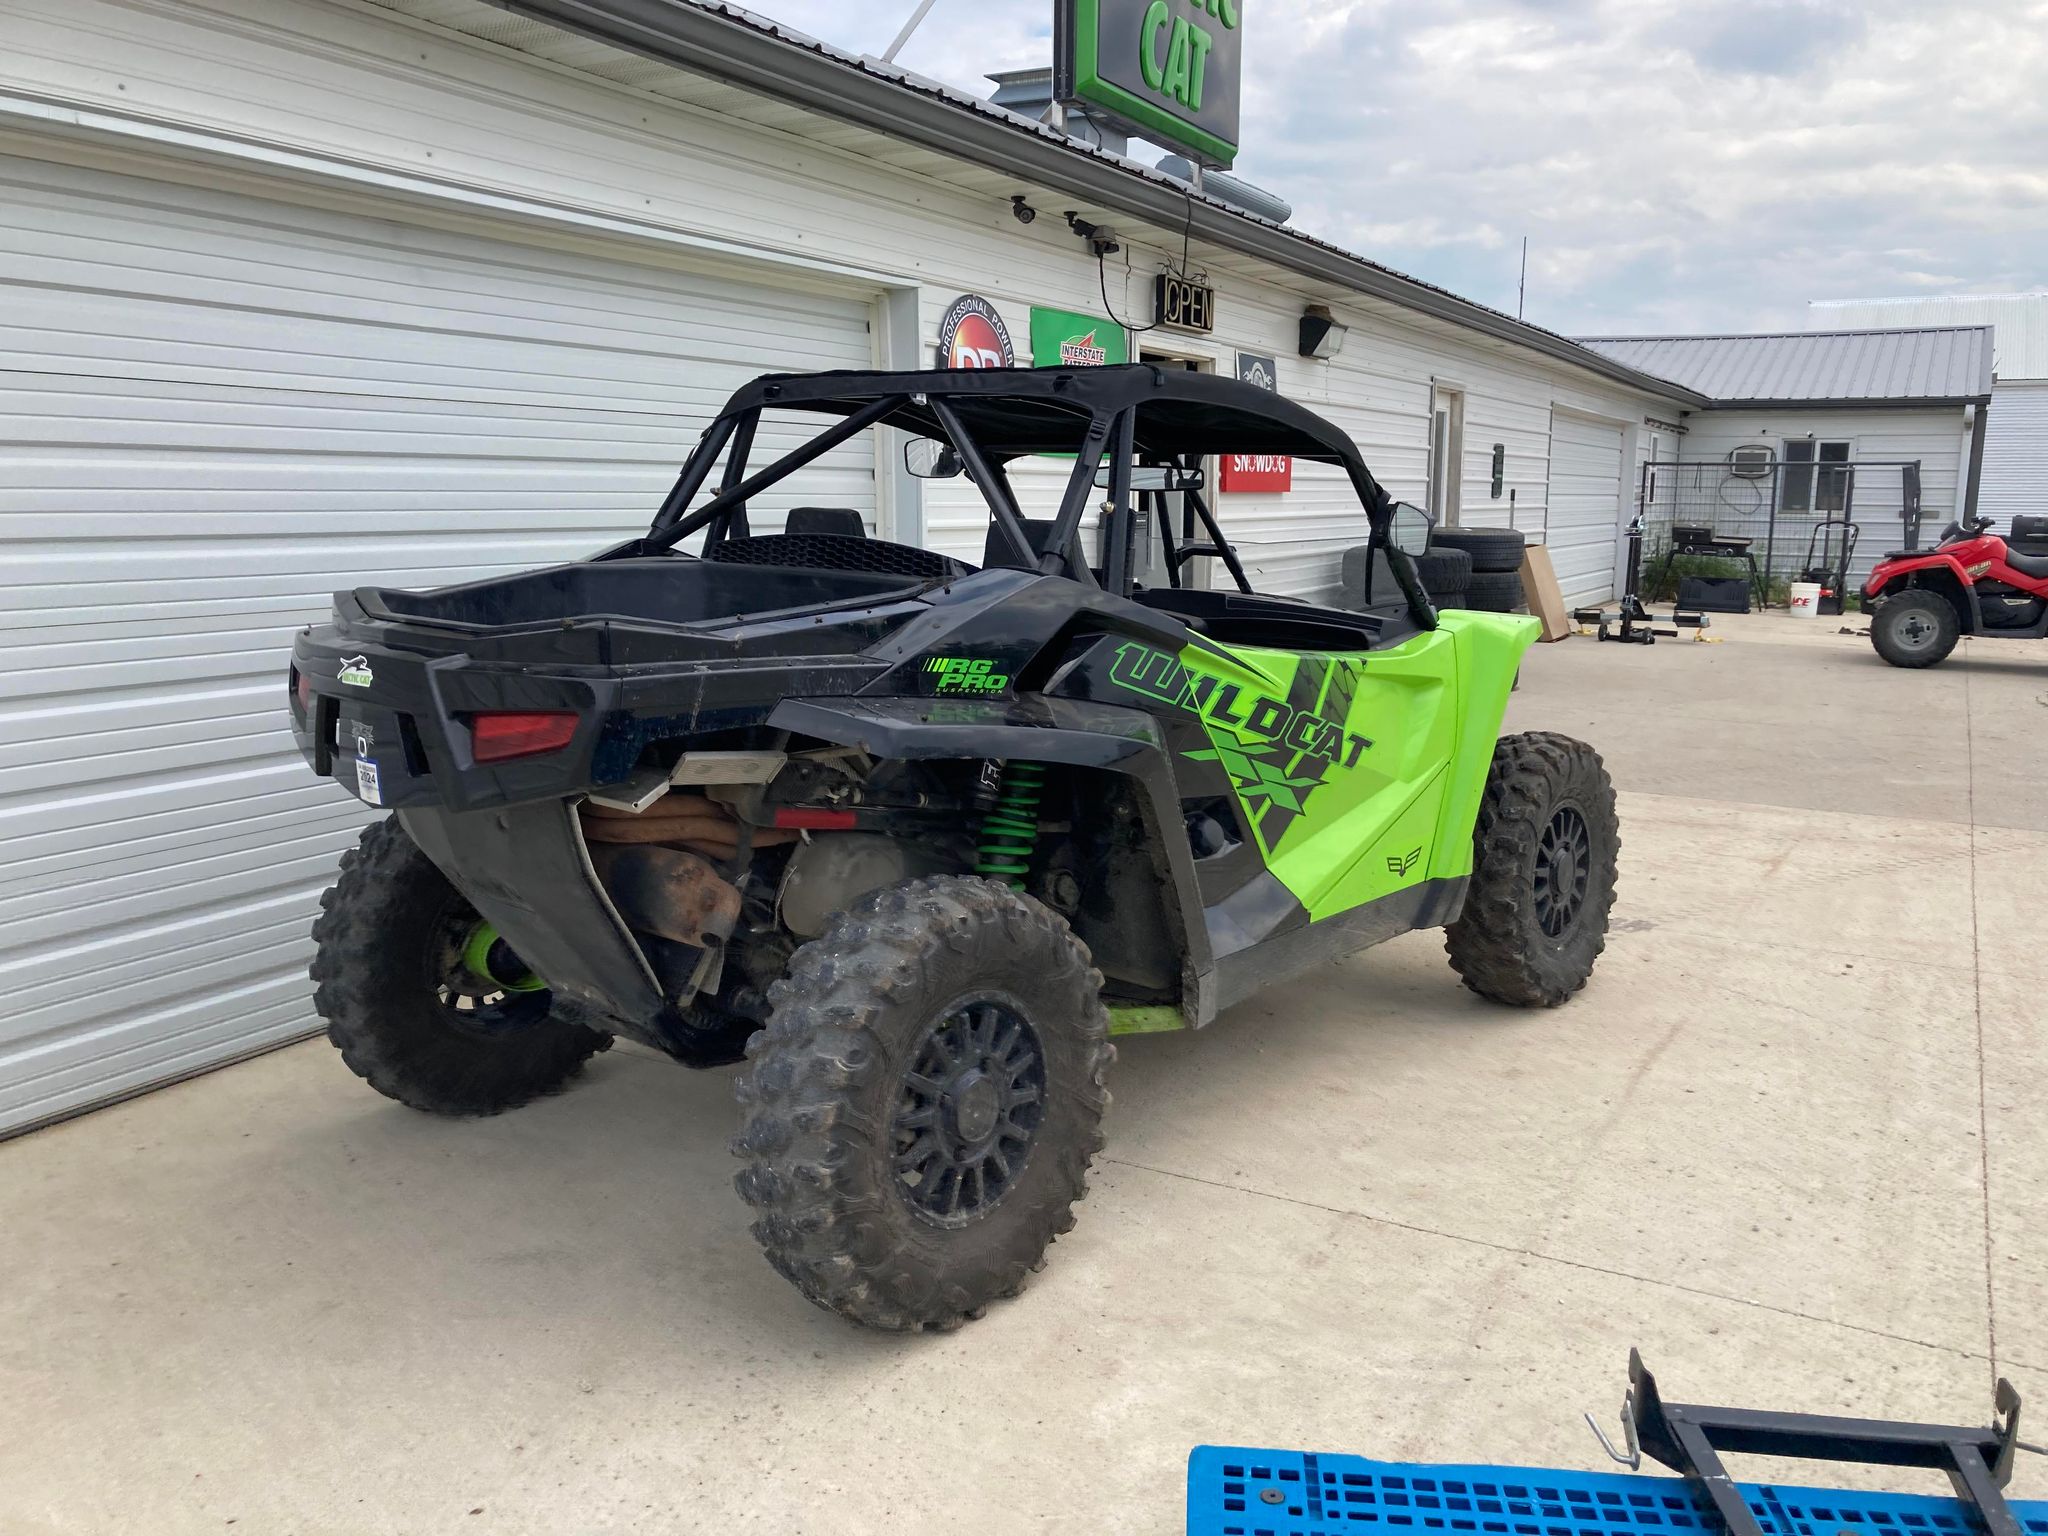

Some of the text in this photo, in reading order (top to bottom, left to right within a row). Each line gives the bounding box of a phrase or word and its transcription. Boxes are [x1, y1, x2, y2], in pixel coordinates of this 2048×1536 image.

[1139, 0, 1212, 112] CAT
[1167, 280, 1213, 329] OPEN
[942, 300, 1014, 365] PROFESSIONAL POWER
[1061, 344, 1105, 361] INTERSTATE
[937, 673, 1009, 689] PRO
[944, 658, 993, 674] RG
[935, 687, 1004, 695] SUSPENSION
[1109, 642, 1376, 769] WILDCAT
